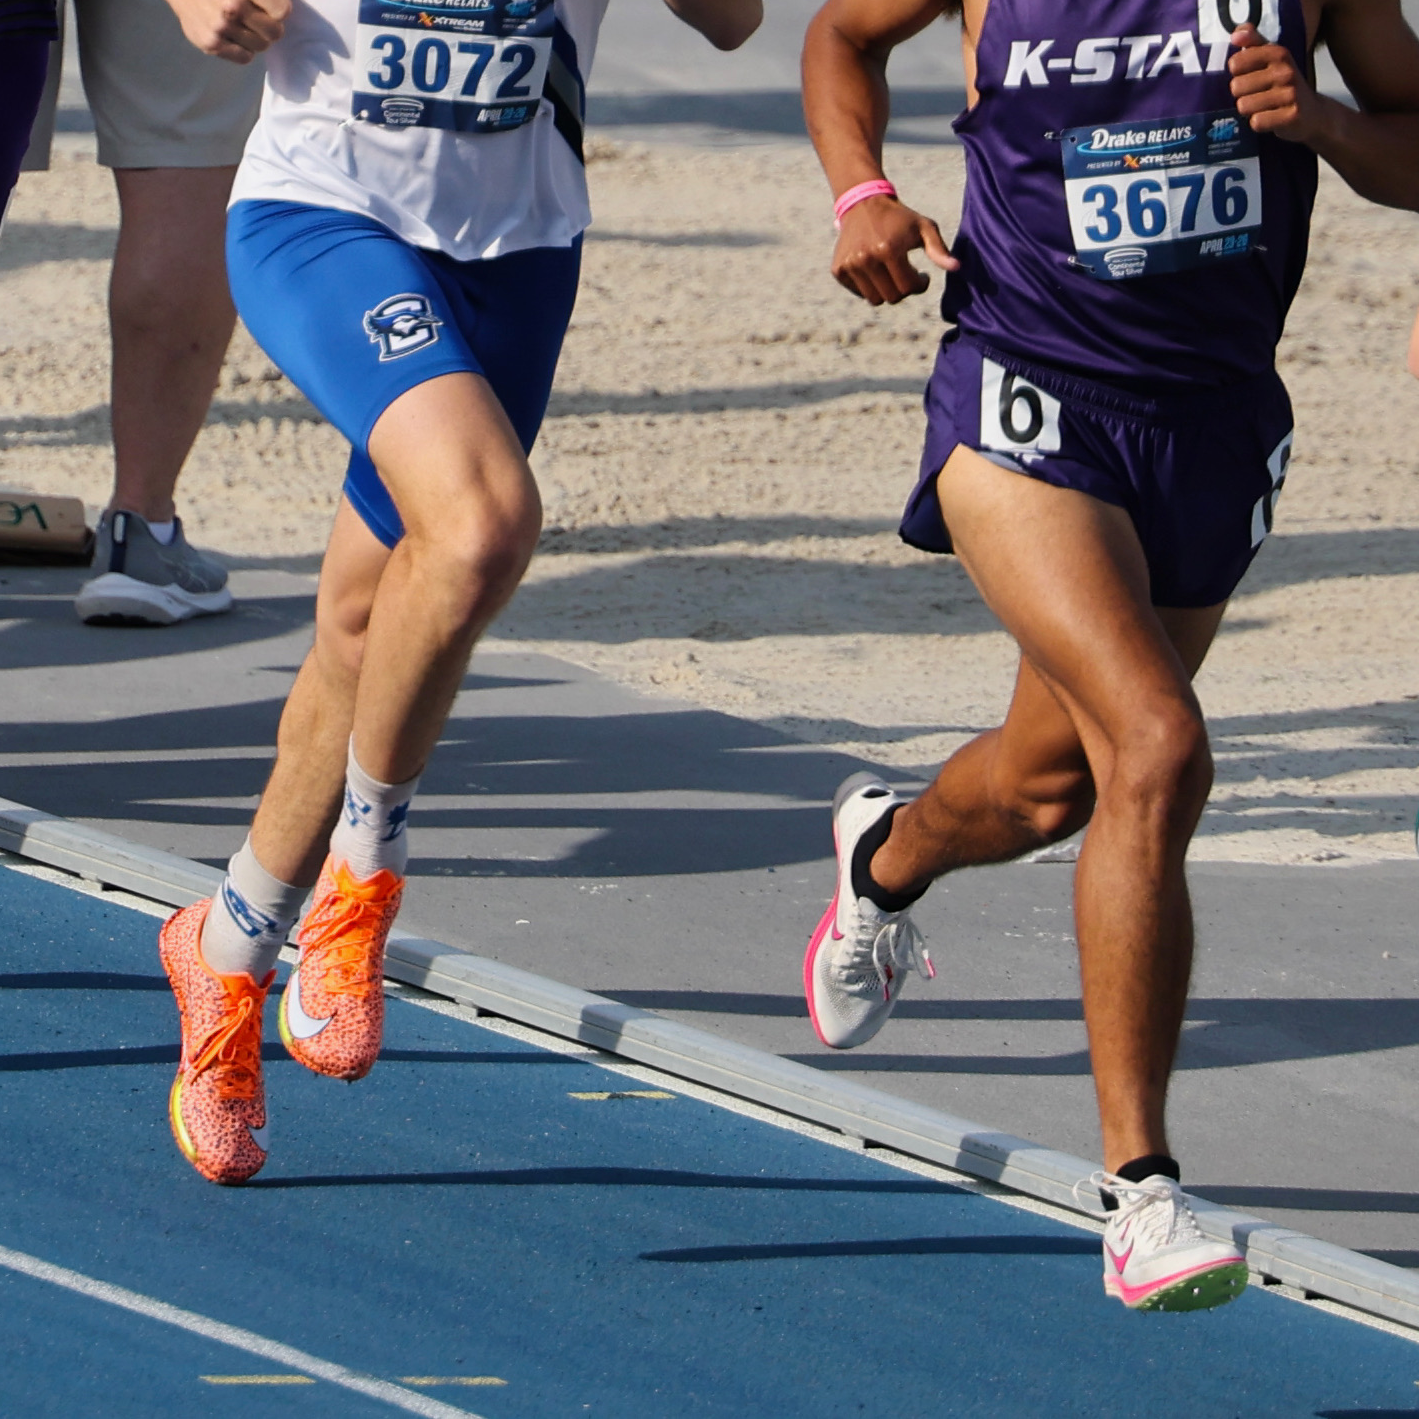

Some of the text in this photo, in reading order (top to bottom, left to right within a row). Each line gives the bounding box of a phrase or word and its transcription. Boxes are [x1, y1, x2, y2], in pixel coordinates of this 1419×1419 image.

[434, 17, 485, 27] XTREAM
[368, 34, 535, 99] 3072
[384, 110, 420, 119] Continental
[477, 109, 502, 122] APRIL
[1090, 126, 1191, 150] Drake RELAYS
[1140, 152, 1190, 164] XTREAM
[1082, 167, 1248, 243] 3676
[1200, 240, 1223, 255] APRIL
[1108, 260, 1144, 271] Continental
[1112, 267, 1143, 277] Tour Silver
[997, 371, 1043, 444] 6
